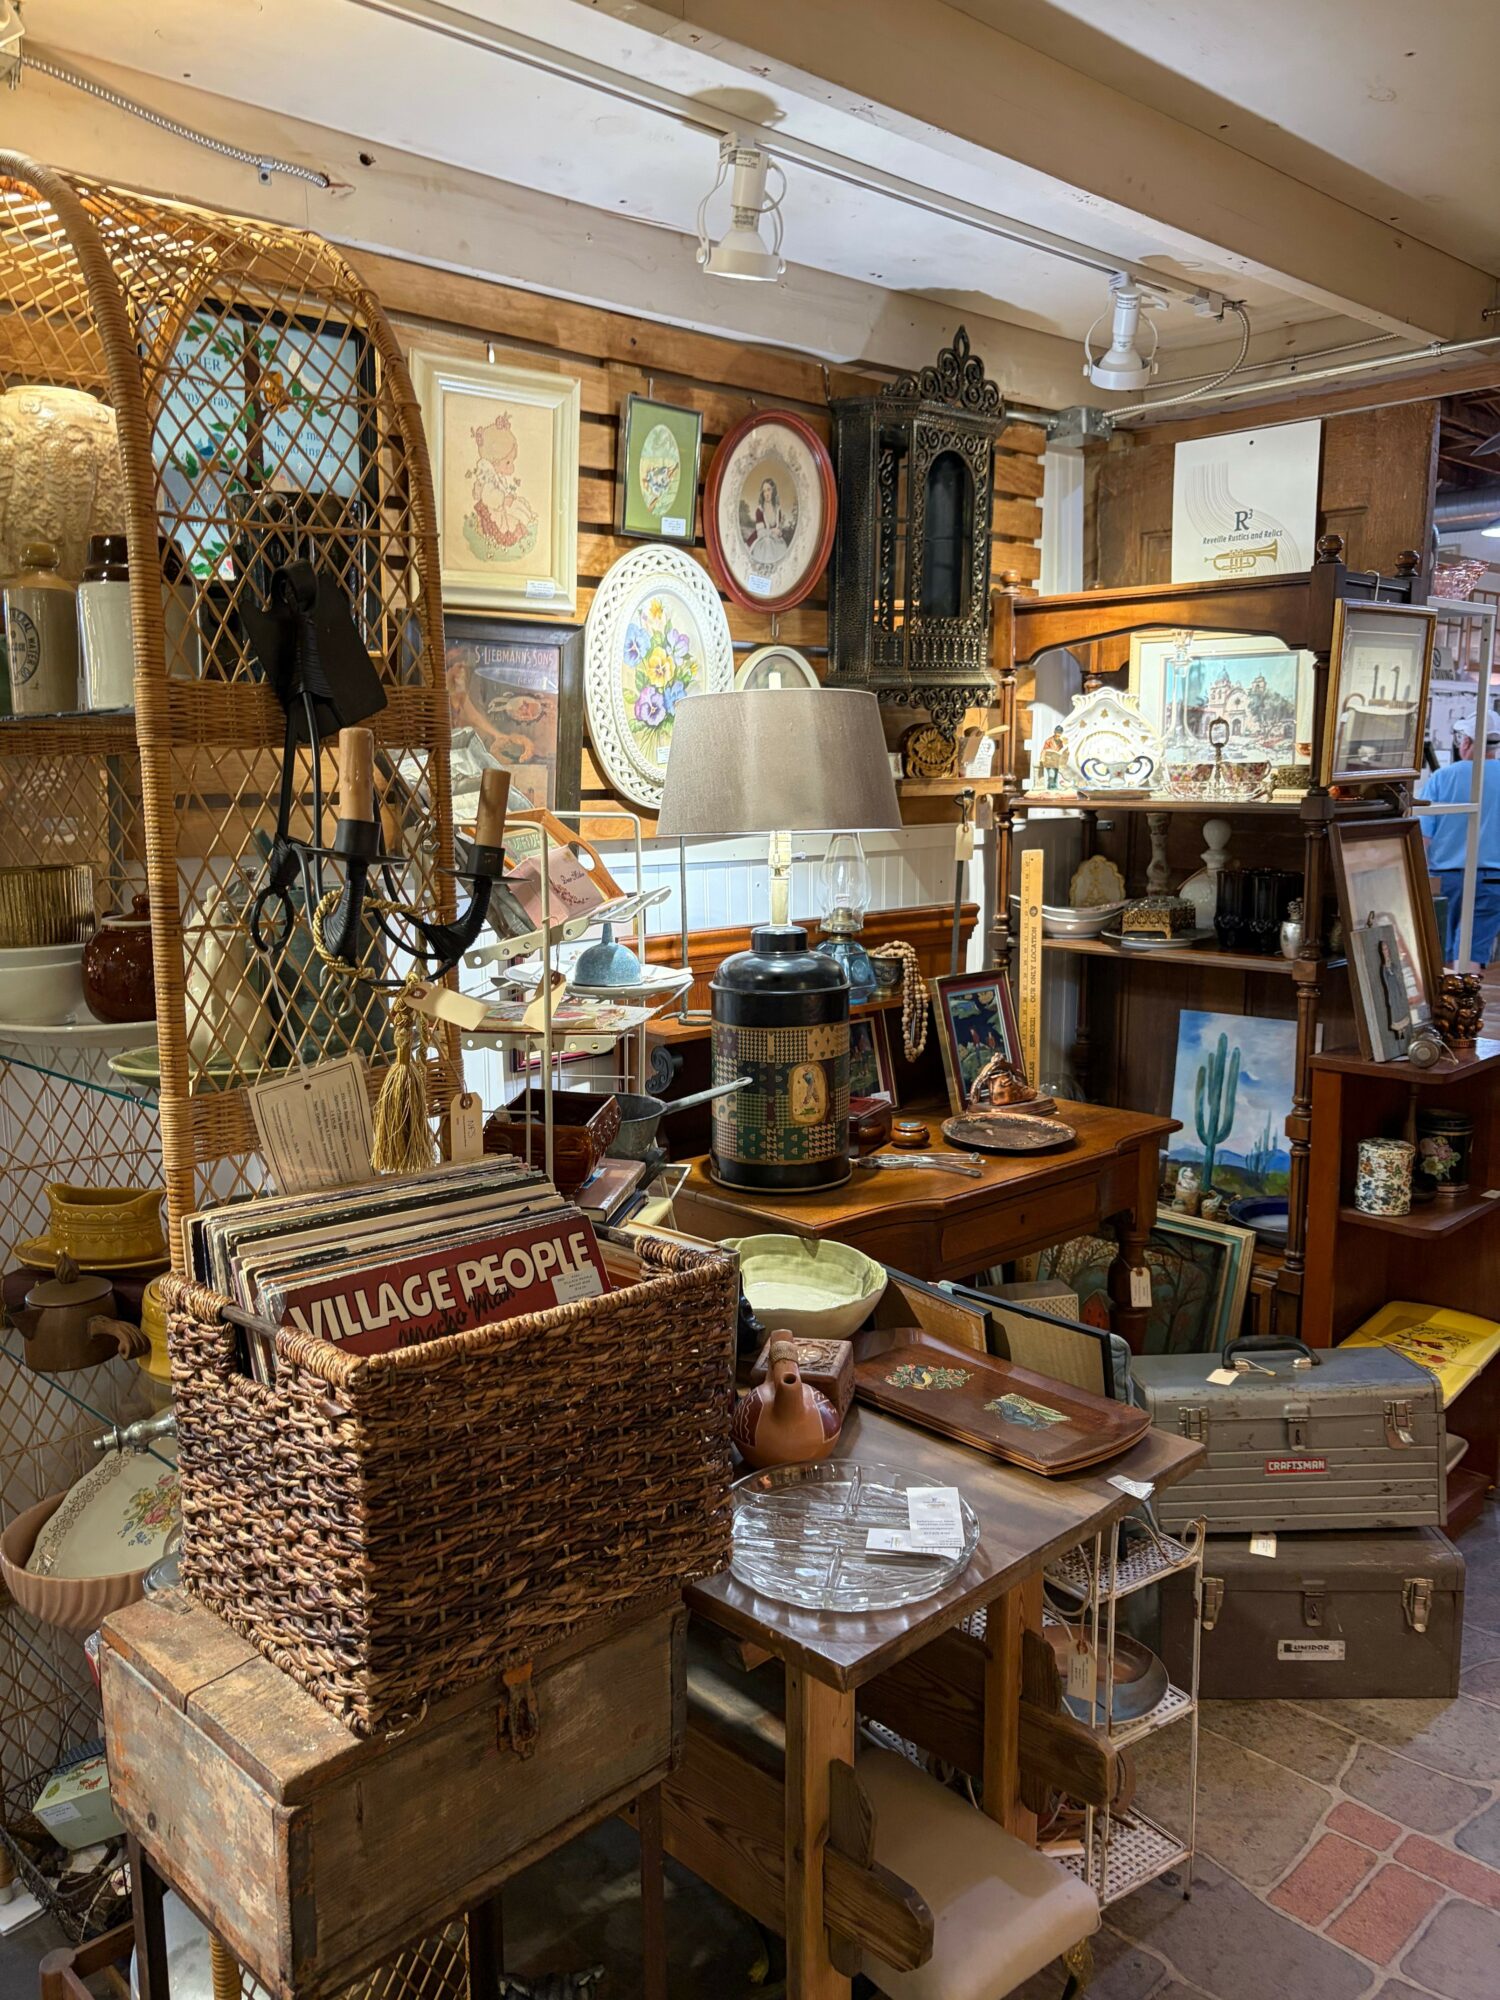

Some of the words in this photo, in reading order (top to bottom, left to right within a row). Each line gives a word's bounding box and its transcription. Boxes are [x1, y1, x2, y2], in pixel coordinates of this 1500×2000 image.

[1202, 535, 1227, 545] Reveille
[1228, 533, 1250, 542] Rustics
[1251, 531, 1263, 539] and
[1264, 529, 1283, 538] Relics
[532, 649, 554, 667] SONS
[288, 1267, 457, 1343] VILLAGE
[456, 1231, 594, 1303] PEOPLE
[398, 1307, 468, 1346] Macho
[467, 1286, 516, 1321] Man
[1268, 1460, 1326, 1471] CRAFTSMAN
